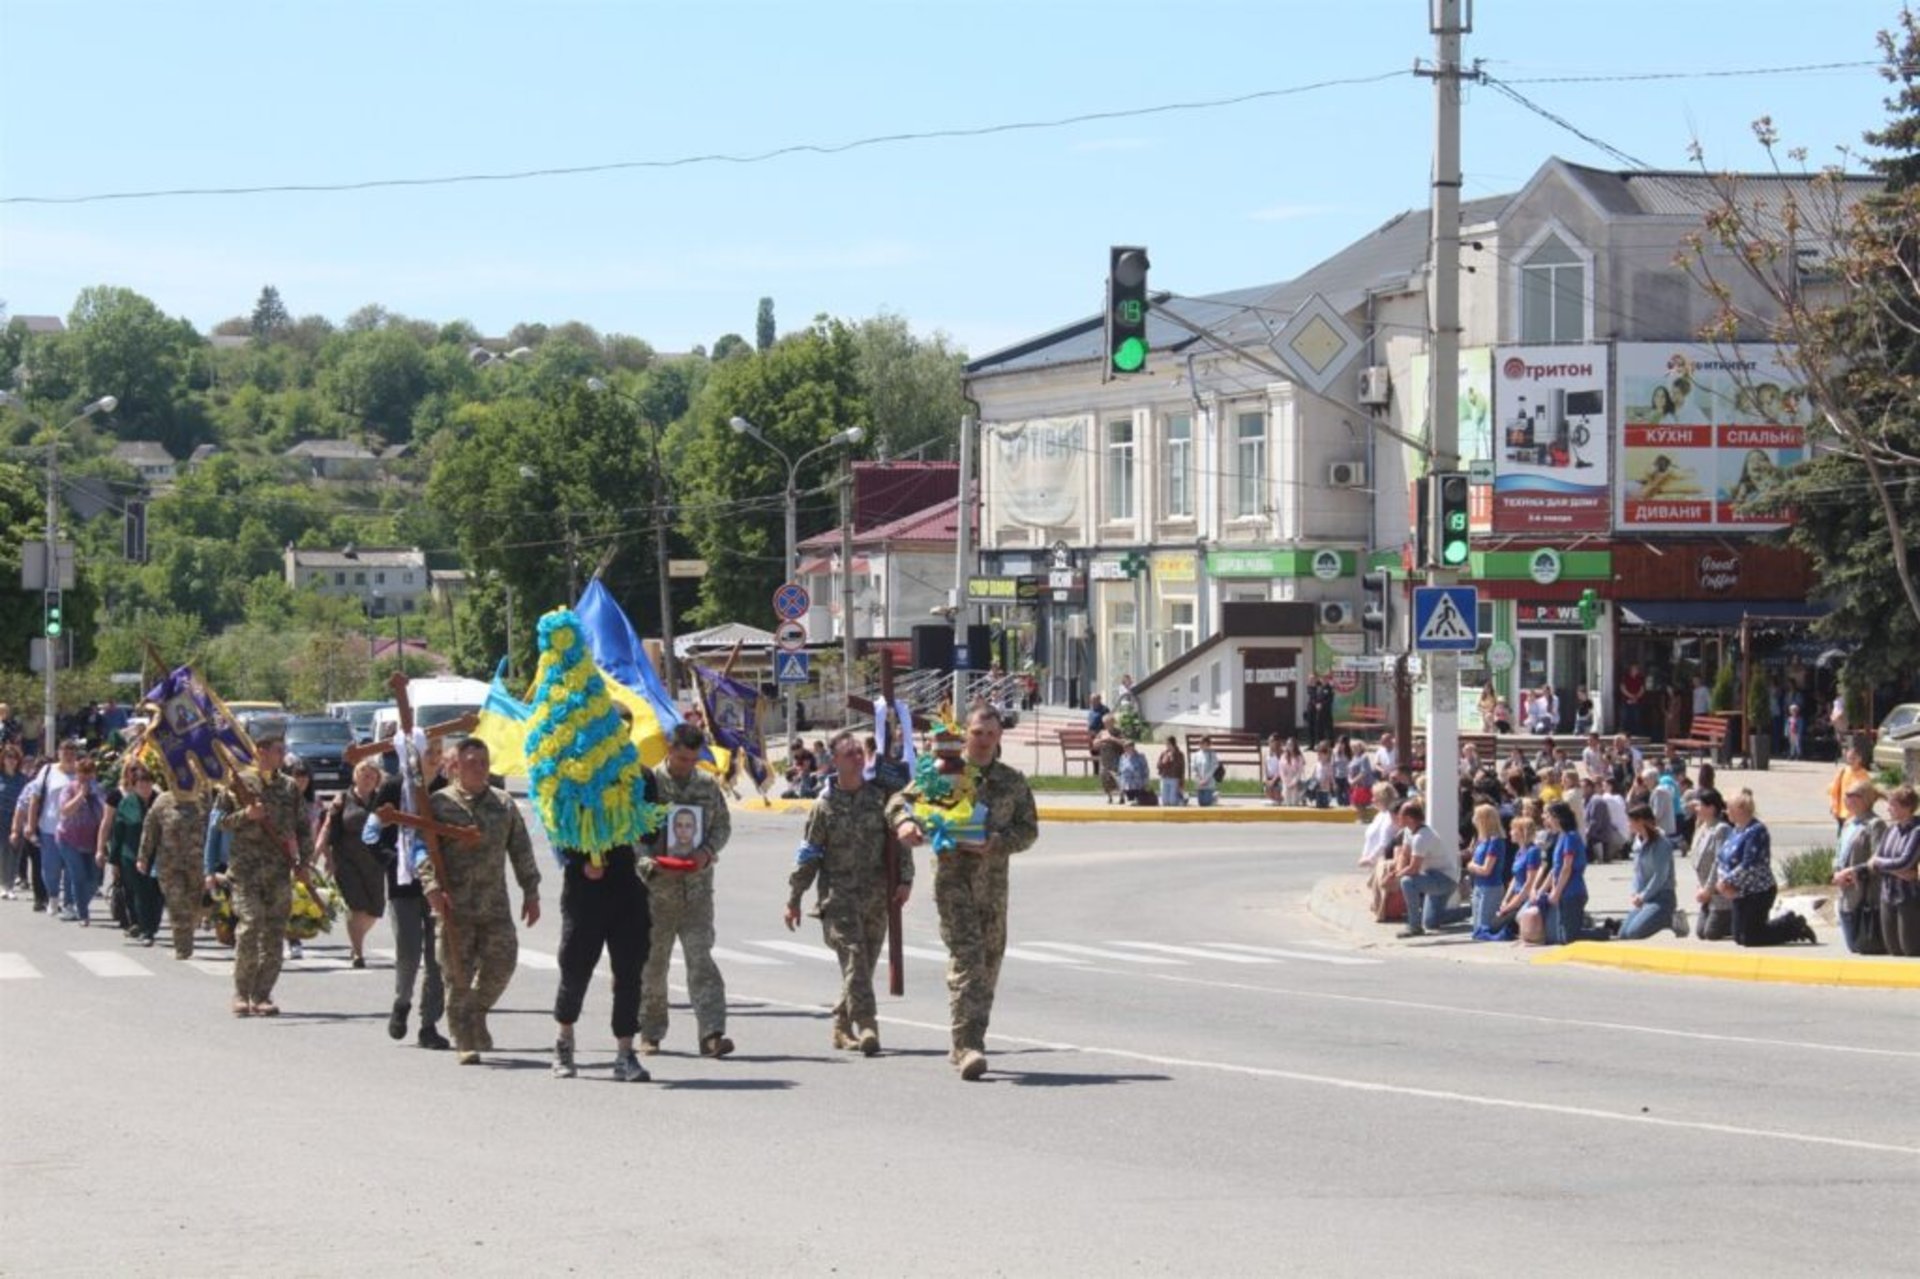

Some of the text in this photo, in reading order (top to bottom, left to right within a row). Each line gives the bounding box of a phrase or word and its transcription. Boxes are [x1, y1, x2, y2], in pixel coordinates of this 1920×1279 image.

[1526, 363, 1593, 381] тритон
[1646, 430, 1693, 442] КУХНІ
[1635, 505, 1702, 520] ДИВАНИ
